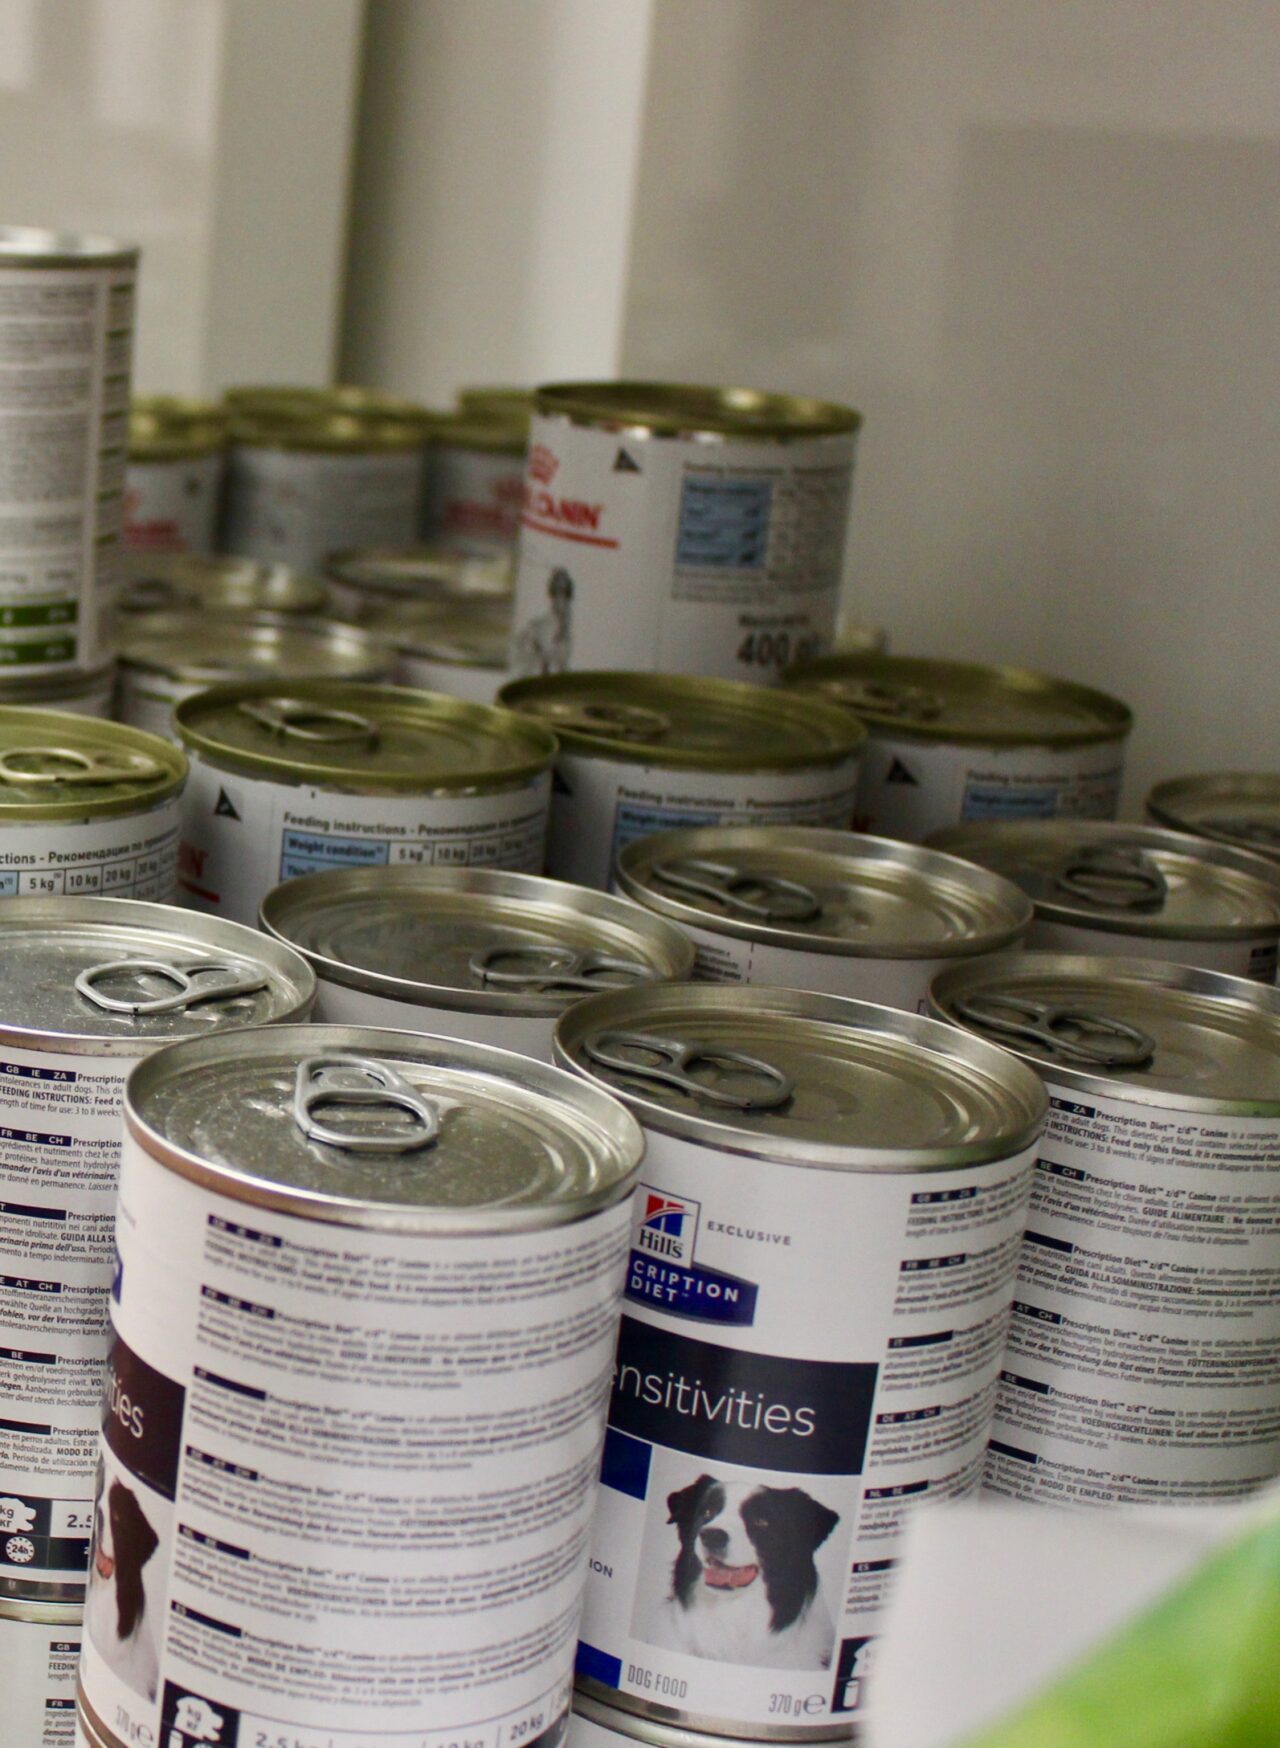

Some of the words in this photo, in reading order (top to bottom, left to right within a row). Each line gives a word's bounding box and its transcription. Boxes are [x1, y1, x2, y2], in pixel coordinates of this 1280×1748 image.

[283, 811, 330, 831] Feeding
[333, 819, 407, 836] instructions
[288, 837, 324, 854] Weight
[29, 877, 37, 890] 5
[40, 877, 55, 892] kg
[70, 874, 81, 887] 10
[85, 873, 98, 888] kg
[105, 870, 117, 883] 20
[6, 1065, 19, 1074] GB
[31, 1069, 41, 1078] IE
[53, 1072, 67, 1080] ZA
[52, 1084, 72, 1092] adult
[74, 1085, 94, 1094] dogs.
[96, 1086, 110, 1094] This
[32, 1090, 92, 1104] INSTRUCTIONS:
[94, 1096, 117, 1106] Feed
[30, 1102, 46, 1112] time
[48, 1103, 58, 1112] for
[58, 1106, 74, 1115] use:
[81, 1106, 89, 1116] to
[1073, 1104, 1086, 1114] ZA
[1096, 1110, 1147, 1128] Prescription
[1200, 1128, 1228, 1138] Canine
[1, 1129, 13, 1138] FR
[26, 1134, 38, 1142] BE
[48, 1136, 63, 1144] CH
[73, 1138, 122, 1150] Prescription
[1050, 1120, 1108, 1142] INSTRUCTIONS:
[1111, 1136, 1130, 1147] Feed
[1133, 1140, 1151, 1152] only
[1153, 1144, 1169, 1154] this
[1171, 1147, 1192, 1156] food.
[44, 1146, 82, 1158] nutriments
[84, 1150, 100, 1158] chez
[40, 1156, 80, 1168] hautement
[32, 1166, 52, 1176] l'avis
[54, 1168, 70, 1178] d'un
[7, 1173, 29, 1184] donné
[41, 1178, 87, 1190] permanence.
[88, 1182, 112, 1192] Laisser
[1062, 1168, 1076, 1178] CH
[1086, 1173, 1136, 1191] Prescription
[1188, 1192, 1216, 1201] Canine
[68, 1212, 116, 1223] Prescription
[1142, 1206, 1168, 1218] GUIDE
[1171, 1211, 1225, 1224] ALIMENTAIRE
[82, 1224, 97, 1232] cani
[707, 1220, 792, 1246] EXCLUSIVE
[30, 1240, 54, 1250] prima
[60, 1232, 85, 1242] GUIDA
[86, 1234, 106, 1243] ALLA
[639, 1228, 683, 1259] Hill's
[29, 1251, 52, 1262] tempo
[1074, 1246, 1122, 1262] Prescription
[1171, 1264, 1198, 1274] Canine
[1065, 1264, 1089, 1278] GUIDA
[1091, 1272, 1110, 1282] ALLA
[16, 1280, 29, 1288] AT
[38, 1282, 53, 1290] CH
[63, 1284, 111, 1295] Prescription
[29, 1302, 52, 1312] Quelle
[64, 1305, 104, 1317] hochgradig
[42, 1313, 55, 1322] der
[56, 1314, 104, 1326] Verwendung
[1062, 1316, 1110, 1335] Prescription
[1161, 1335, 1188, 1346] Canine
[11, 1351, 23, 1360] BE
[58, 1356, 106, 1367] Prescription
[25, 1384, 66, 1396] Aanbevolen
[53, 1426, 100, 1437] Prescription
[56, 1448, 80, 1456] MODO
[82, 1448, 93, 1456] DE
[0, 1504, 15, 1518] kg
[48, 1662, 76, 1670] FEEDIN
[627, 1663, 652, 1692] DOG
[655, 1671, 688, 1699] FOOD
[768, 1692, 791, 1715] 370
[510, 1721, 527, 1741] 20
[529, 1712, 544, 1731] kg
